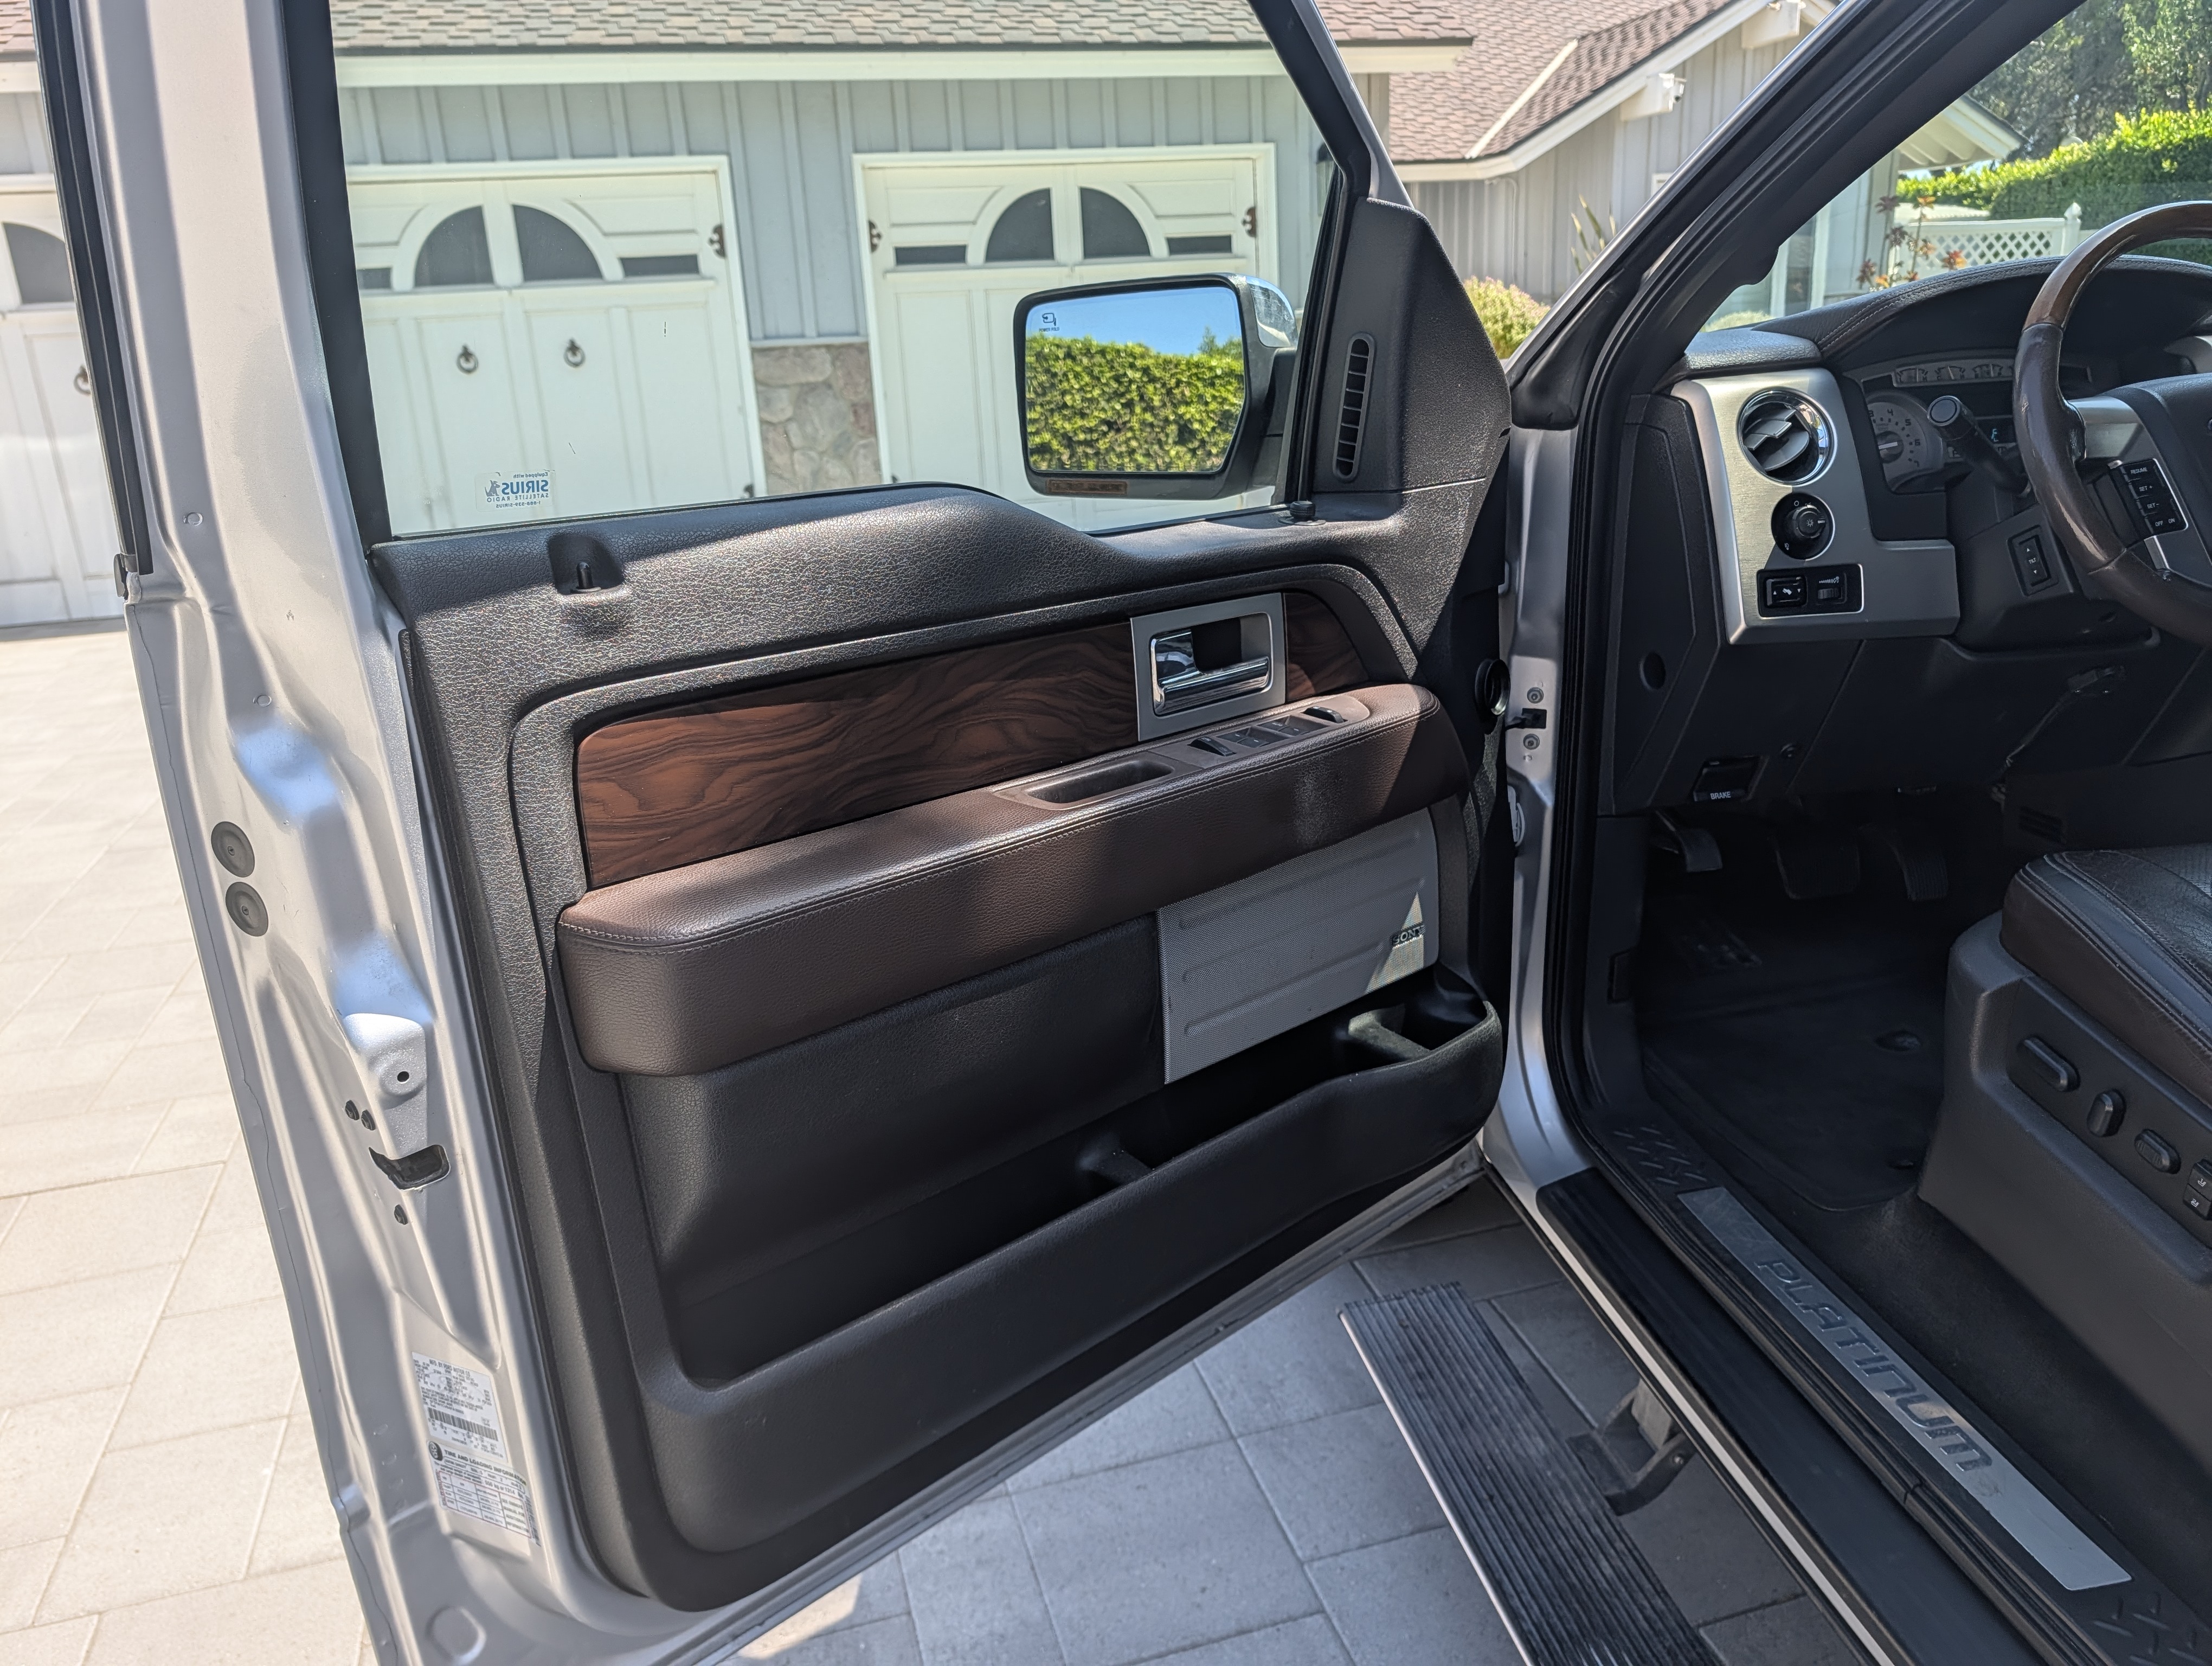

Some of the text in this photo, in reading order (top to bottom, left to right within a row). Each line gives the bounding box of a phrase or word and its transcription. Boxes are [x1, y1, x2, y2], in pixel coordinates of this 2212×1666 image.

[1710, 791, 1731, 800] BRAKE
[1392, 925, 1424, 944] SONY
[1758, 1259, 1994, 1473] PLATINUM
[443, 1449, 456, 1458] TIRE
[456, 1453, 468, 1462] AND
[468, 1457, 493, 1470] LOADING
